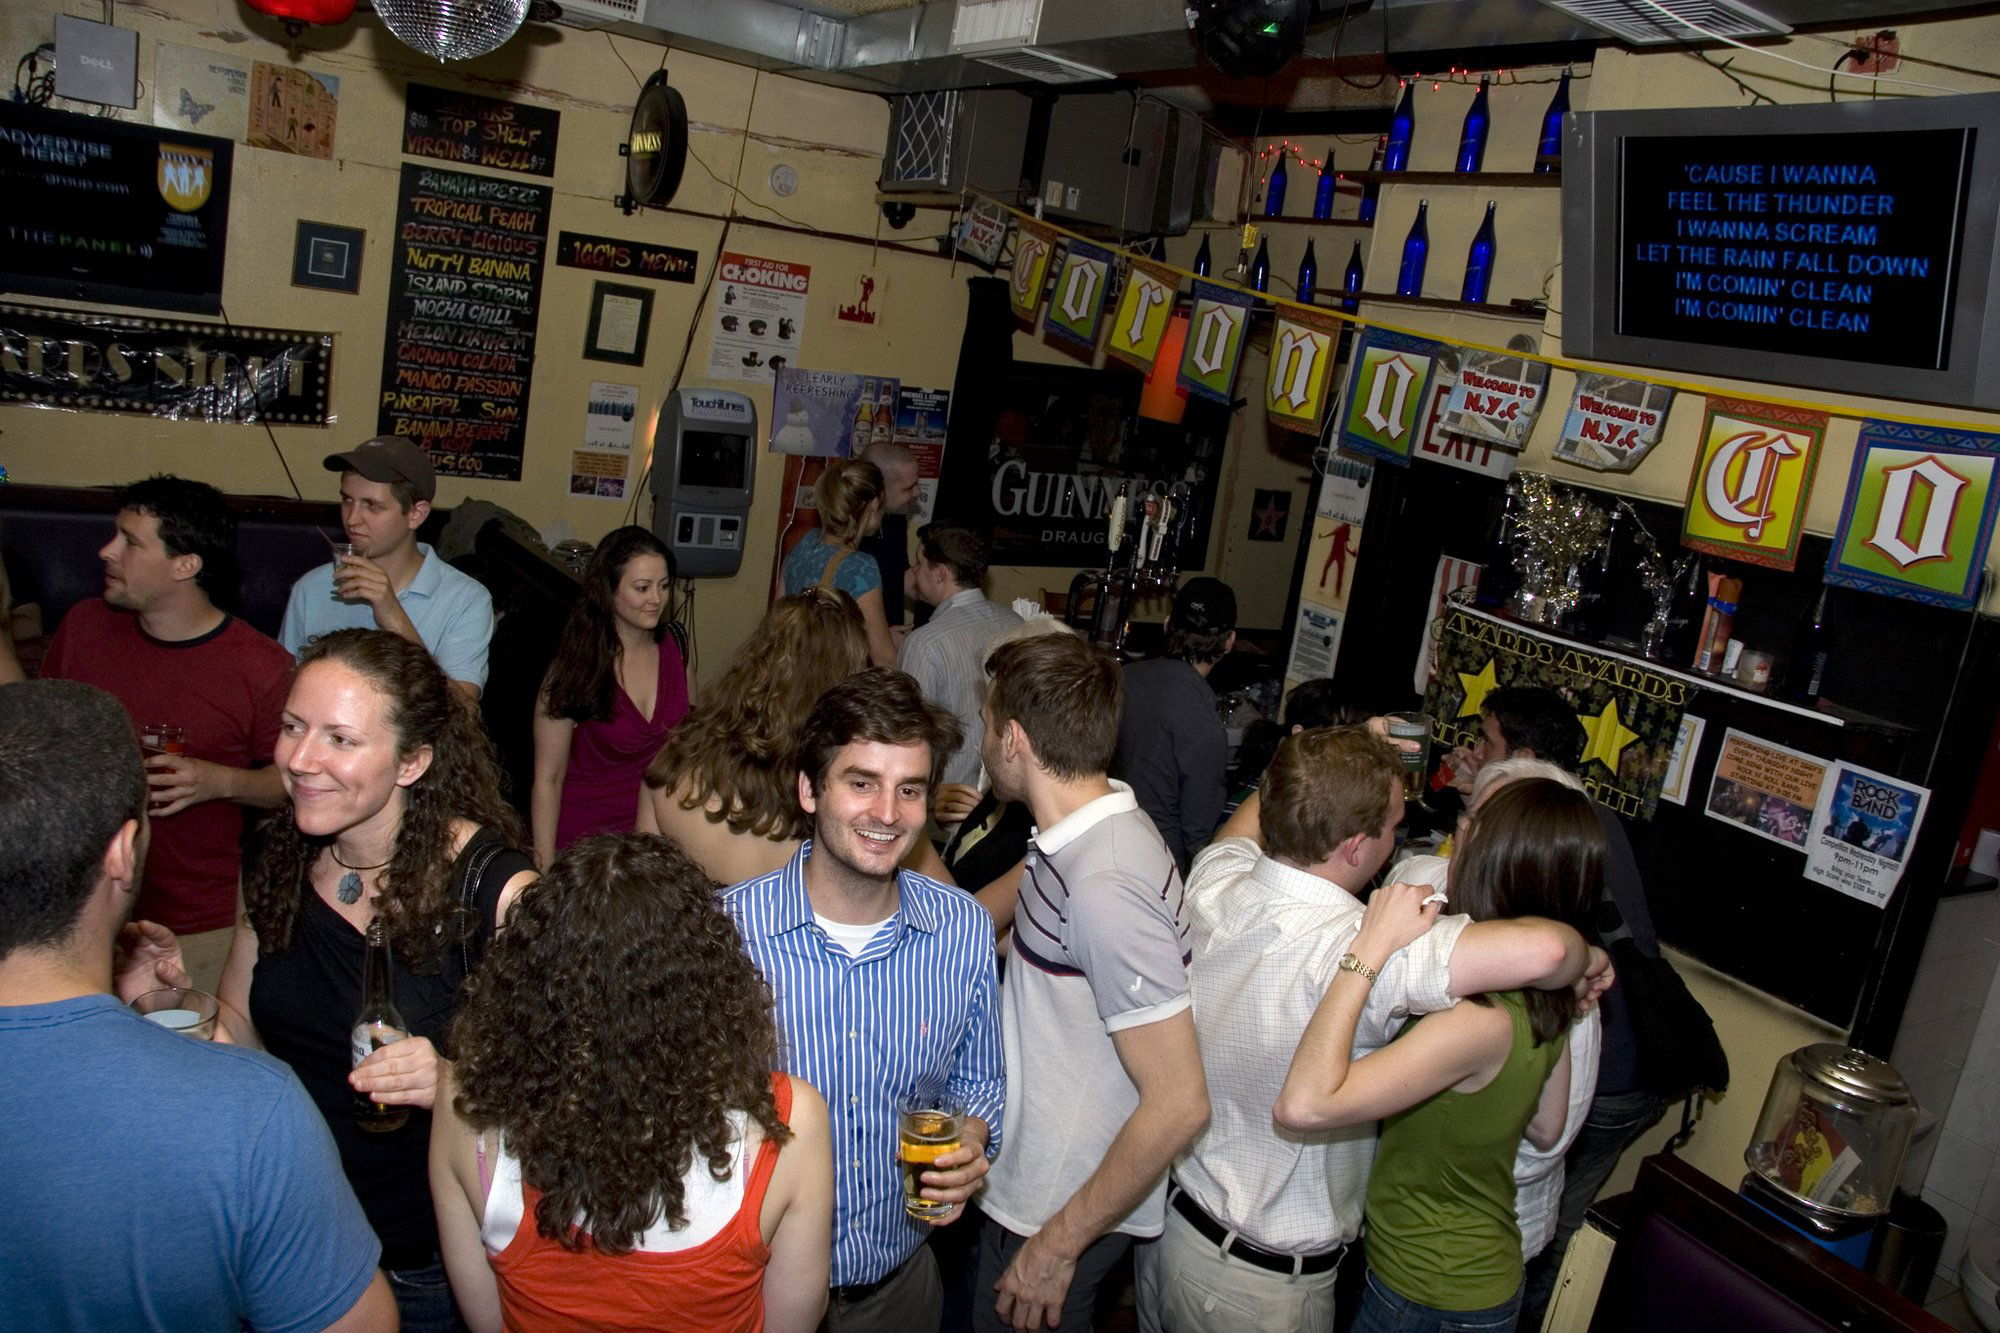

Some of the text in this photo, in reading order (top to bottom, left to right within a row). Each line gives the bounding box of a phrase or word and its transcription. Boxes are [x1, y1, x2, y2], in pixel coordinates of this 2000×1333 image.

[0, 126, 113, 160] ADVERTISE
[439, 116, 477, 136] TOP
[482, 123, 542, 148] SHELF
[480, 145, 530, 170] WELL
[418, 170, 540, 203] BAHAMA BREEZE
[1684, 164, 1876, 186] 'CAUSE I WANNA
[409, 197, 538, 233] TROPICAL PEACH
[1667, 191, 1895, 217] FEEL THE THUNDER
[5, 223, 57, 247] THE
[58, 231, 136, 257] PANEL
[1676, 219, 1878, 246] I WANNA SCREAM
[406, 247, 532, 281] NUTTY BANANA
[639, 250, 690, 274] MENU
[744, 258, 790, 273] FIRST AID FOR
[1636, 243, 1929, 279] LET THE RAIN FALL DOWN
[407, 273, 530, 306] ISLAND STORM
[722, 263, 808, 291] CHOKING
[1675, 271, 1873, 305] I'M COMIN' CLEAN
[413, 298, 512, 326] MOCHA CHILL
[1673, 298, 1871, 334] I'M COMIN' CLEAN
[398, 322, 458, 342] MELON
[461, 353, 517, 374] COLADA
[453, 376, 522, 398] PASSION
[785, 383, 853, 400] REFRESHING
[796, 372, 846, 386] CLEARLY
[1462, 370, 1537, 399] WELCOME TO
[1464, 391, 1520, 421] N.Y.C
[1579, 395, 1657, 426] WELCOME TO
[394, 417, 511, 442] BANANA BERRY
[1580, 417, 1640, 450] N.Y.C
[1445, 612, 1686, 706] AWARDS AWARDS
[1790, 766, 1814, 779] NIGHT
[1850, 793, 1897, 819] BAND
[1853, 779, 1900, 809] ROCK
[1833, 852, 1880, 877] 9pm-11pm
